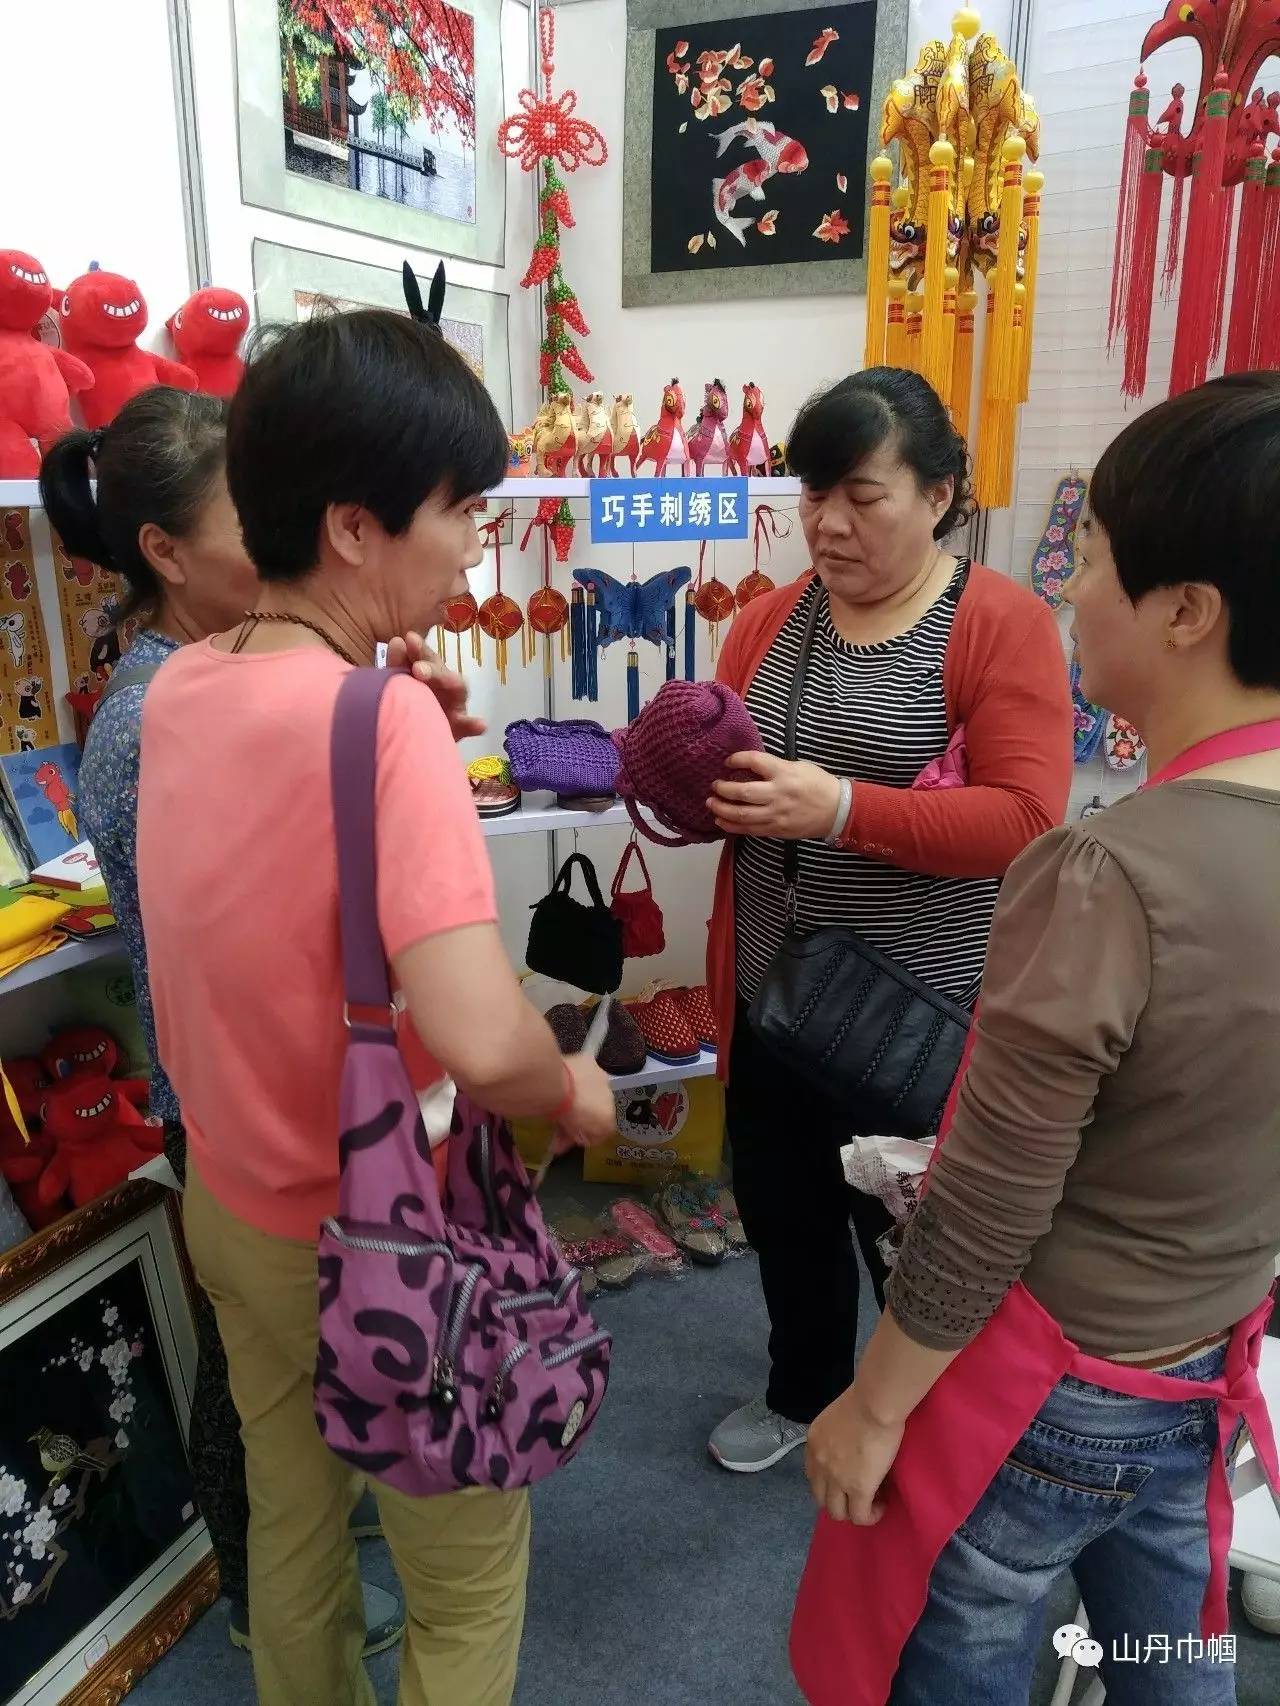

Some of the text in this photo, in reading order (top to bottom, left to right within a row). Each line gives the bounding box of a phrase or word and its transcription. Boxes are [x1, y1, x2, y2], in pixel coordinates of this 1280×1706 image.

[601, 491, 739, 529] 巧手刺绣区
